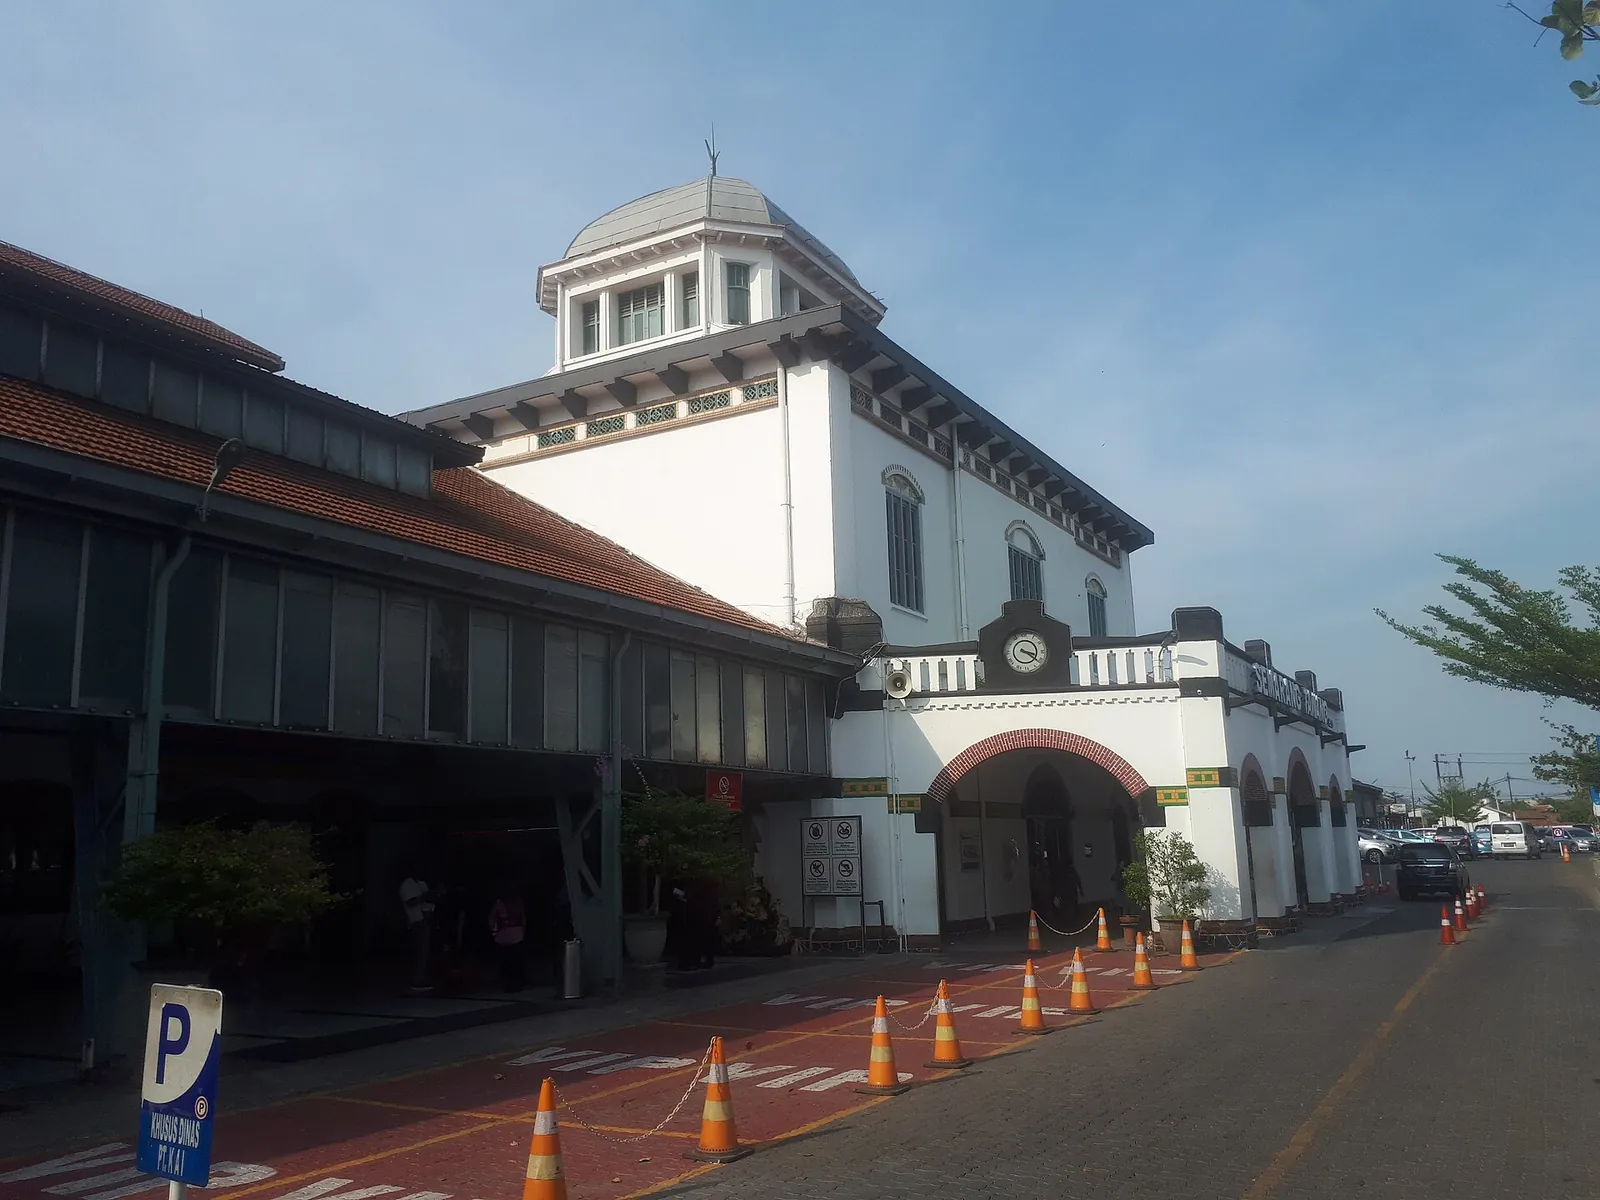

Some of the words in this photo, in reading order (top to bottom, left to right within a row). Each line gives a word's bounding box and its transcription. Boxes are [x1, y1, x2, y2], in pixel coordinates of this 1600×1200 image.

[1252, 663, 1301, 711] SEMARANG
[762, 993, 909, 1011] VIP
[156, 1003, 191, 1084] P
[506, 1046, 697, 1075] VIP
[699, 1062, 913, 1091] VIP
[150, 1112, 178, 1144] KHUSUS
[178, 1117, 201, 1149] DINAS
